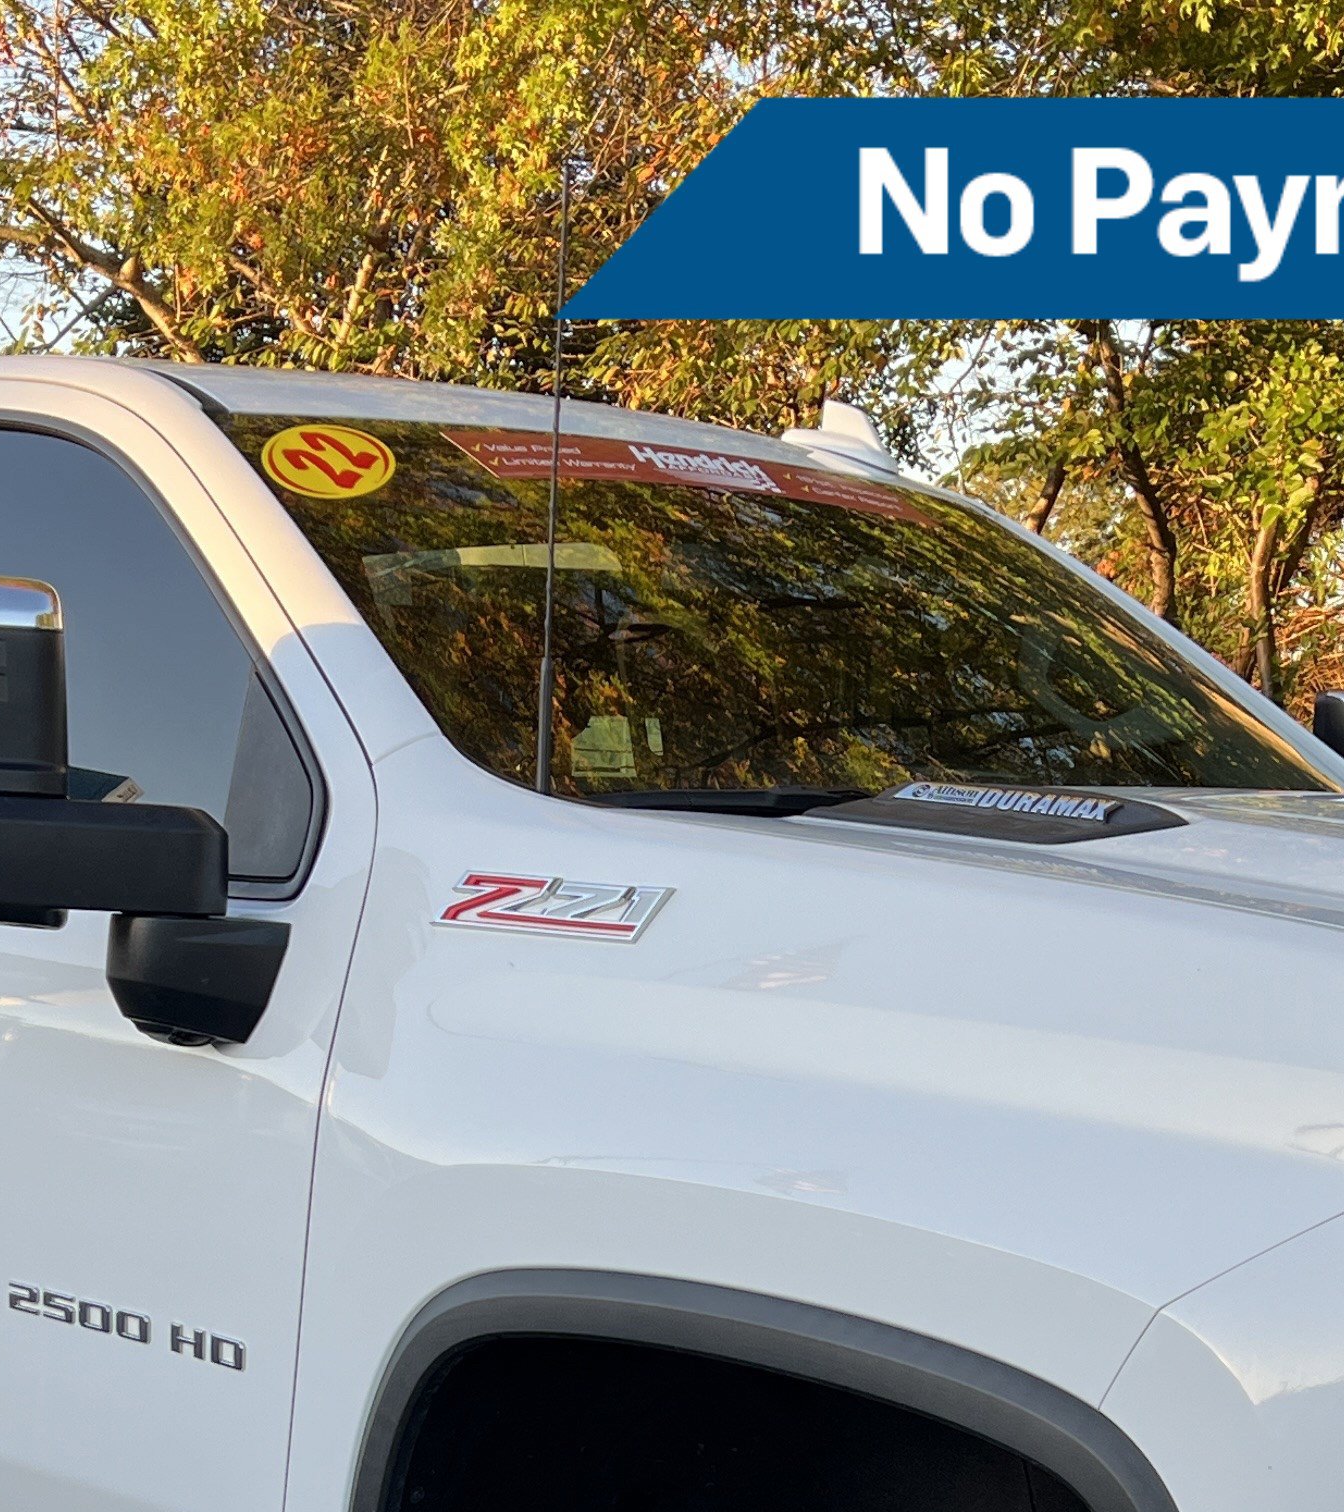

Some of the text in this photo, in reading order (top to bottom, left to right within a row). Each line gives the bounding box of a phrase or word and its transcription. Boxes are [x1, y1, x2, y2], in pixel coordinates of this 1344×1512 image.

[282, 432, 379, 489] 22
[977, 788, 1119, 822] DURAMAX
[8, 1280, 248, 1371] 2500 HD
